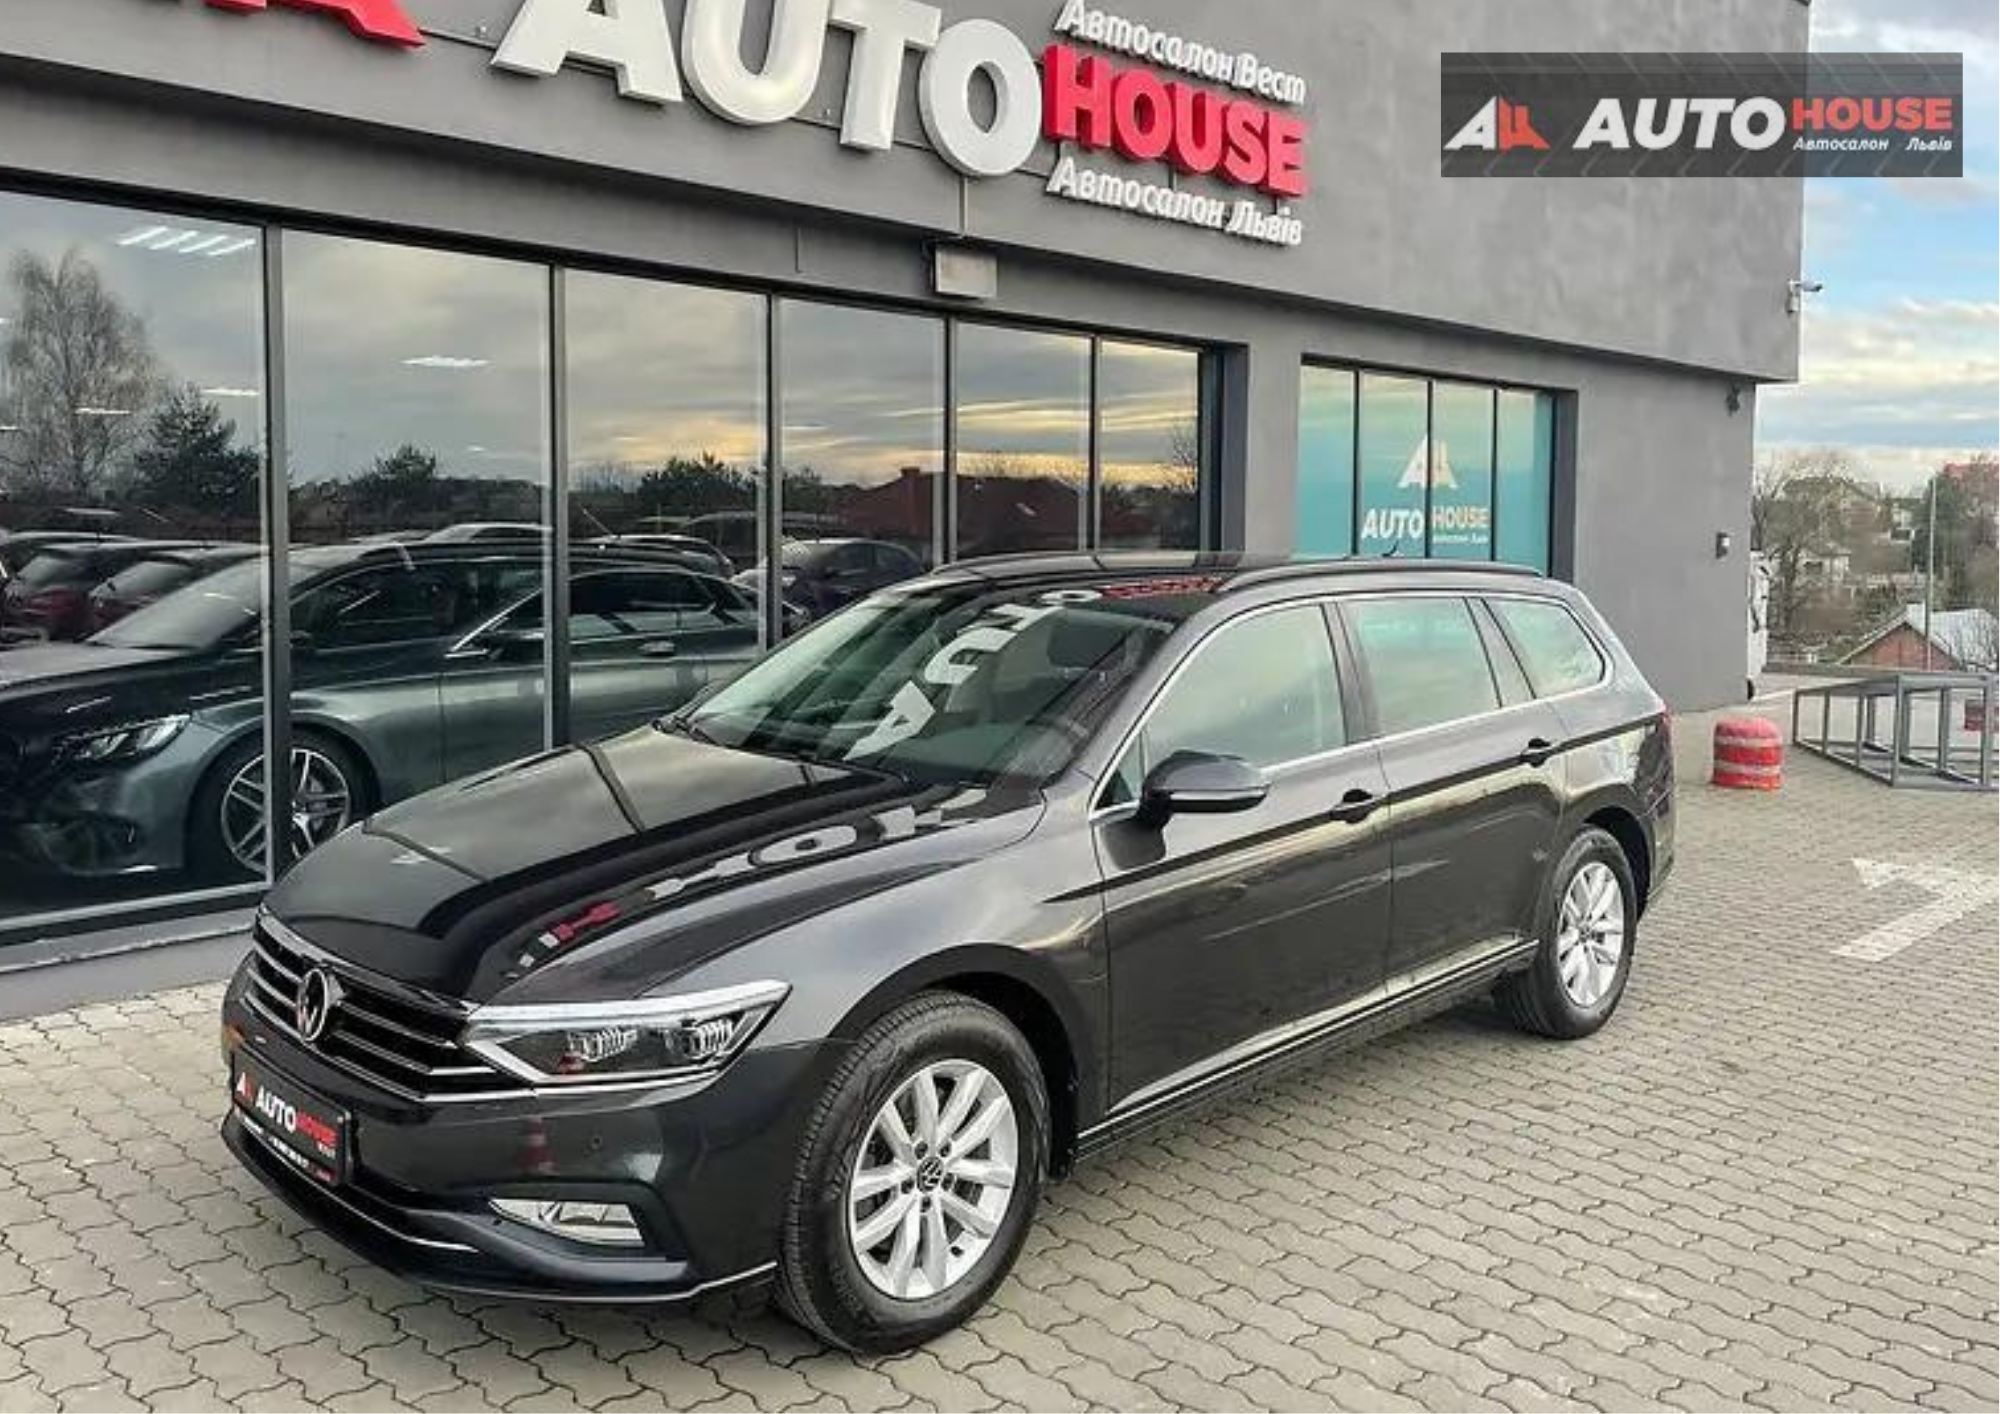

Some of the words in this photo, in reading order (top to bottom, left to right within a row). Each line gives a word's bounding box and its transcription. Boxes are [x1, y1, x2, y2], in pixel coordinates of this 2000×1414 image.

[491, 0, 1042, 178] AUTO
[1054, 0, 1234, 84] Автосалон
[1230, 52, 1306, 104] Вест
[1044, 44, 1308, 197] HOUSE
[1046, 156, 1225, 229] Автосалон
[1225, 199, 1302, 246] Львів
[1361, 508, 1425, 539] AUTO
[1432, 505, 1490, 530] HOUSE
